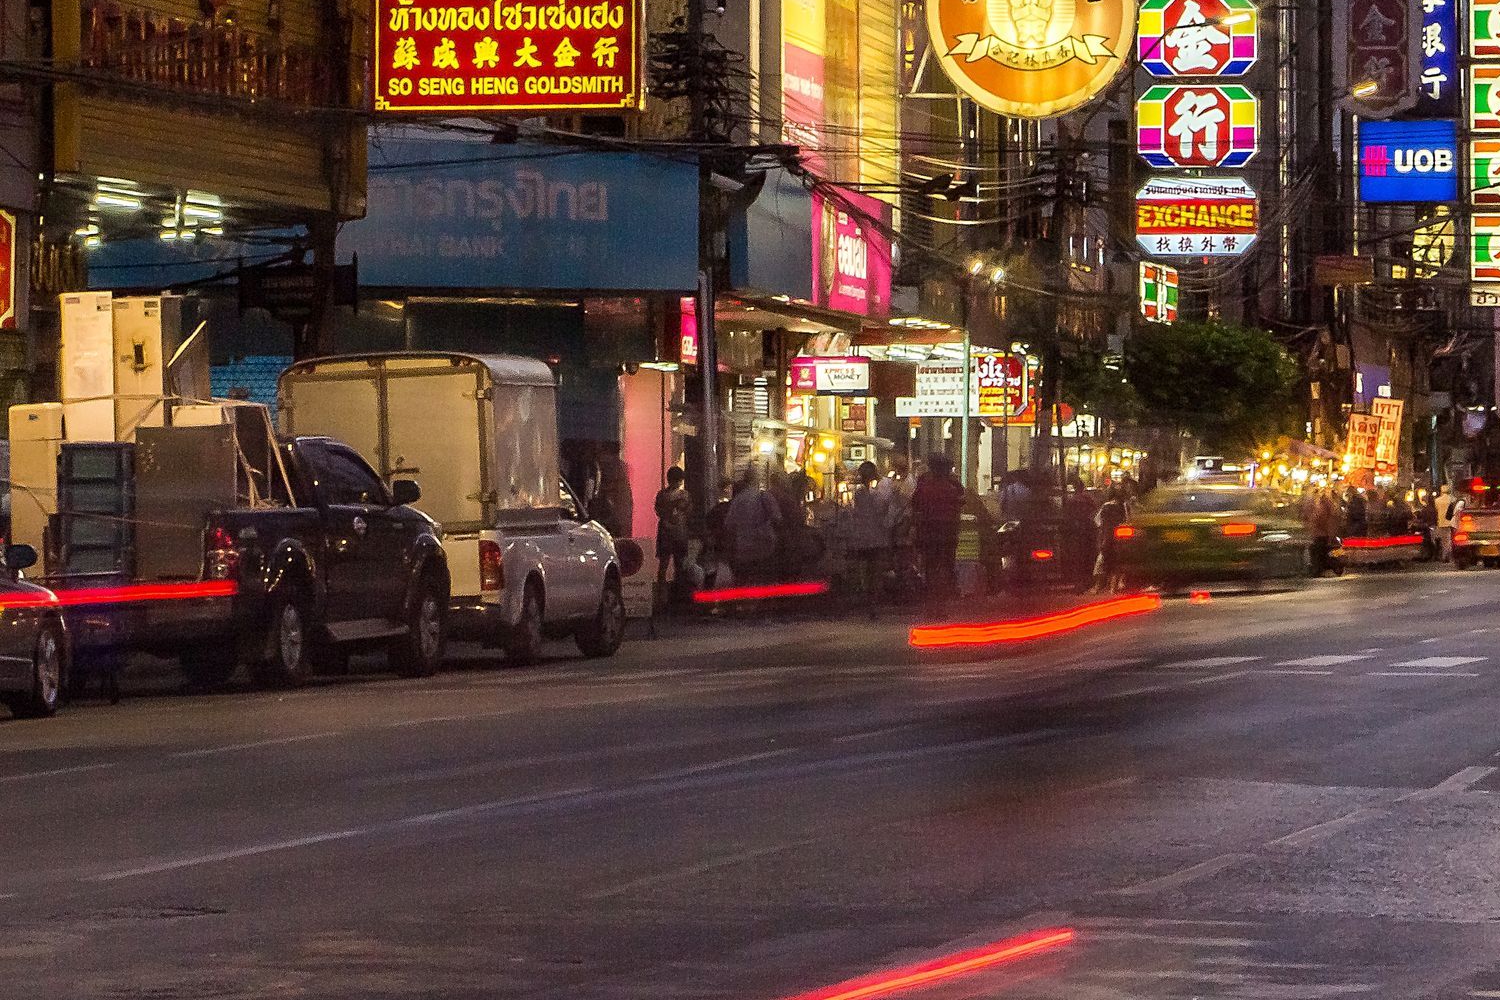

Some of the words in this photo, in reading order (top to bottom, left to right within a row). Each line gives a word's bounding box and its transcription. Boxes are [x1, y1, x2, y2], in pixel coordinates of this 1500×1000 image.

[392, 36, 620, 70] 蘇成興大金行
[388, 78, 413, 96] SO
[418, 77, 465, 95] SENG
[471, 77, 518, 95] HENG
[524, 75, 623, 94] GOLDSMITH
[1393, 149, 1453, 173] UOB
[1138, 204, 1255, 228] EXCHANGE
[1156, 236, 1240, 252] 找換外幣
